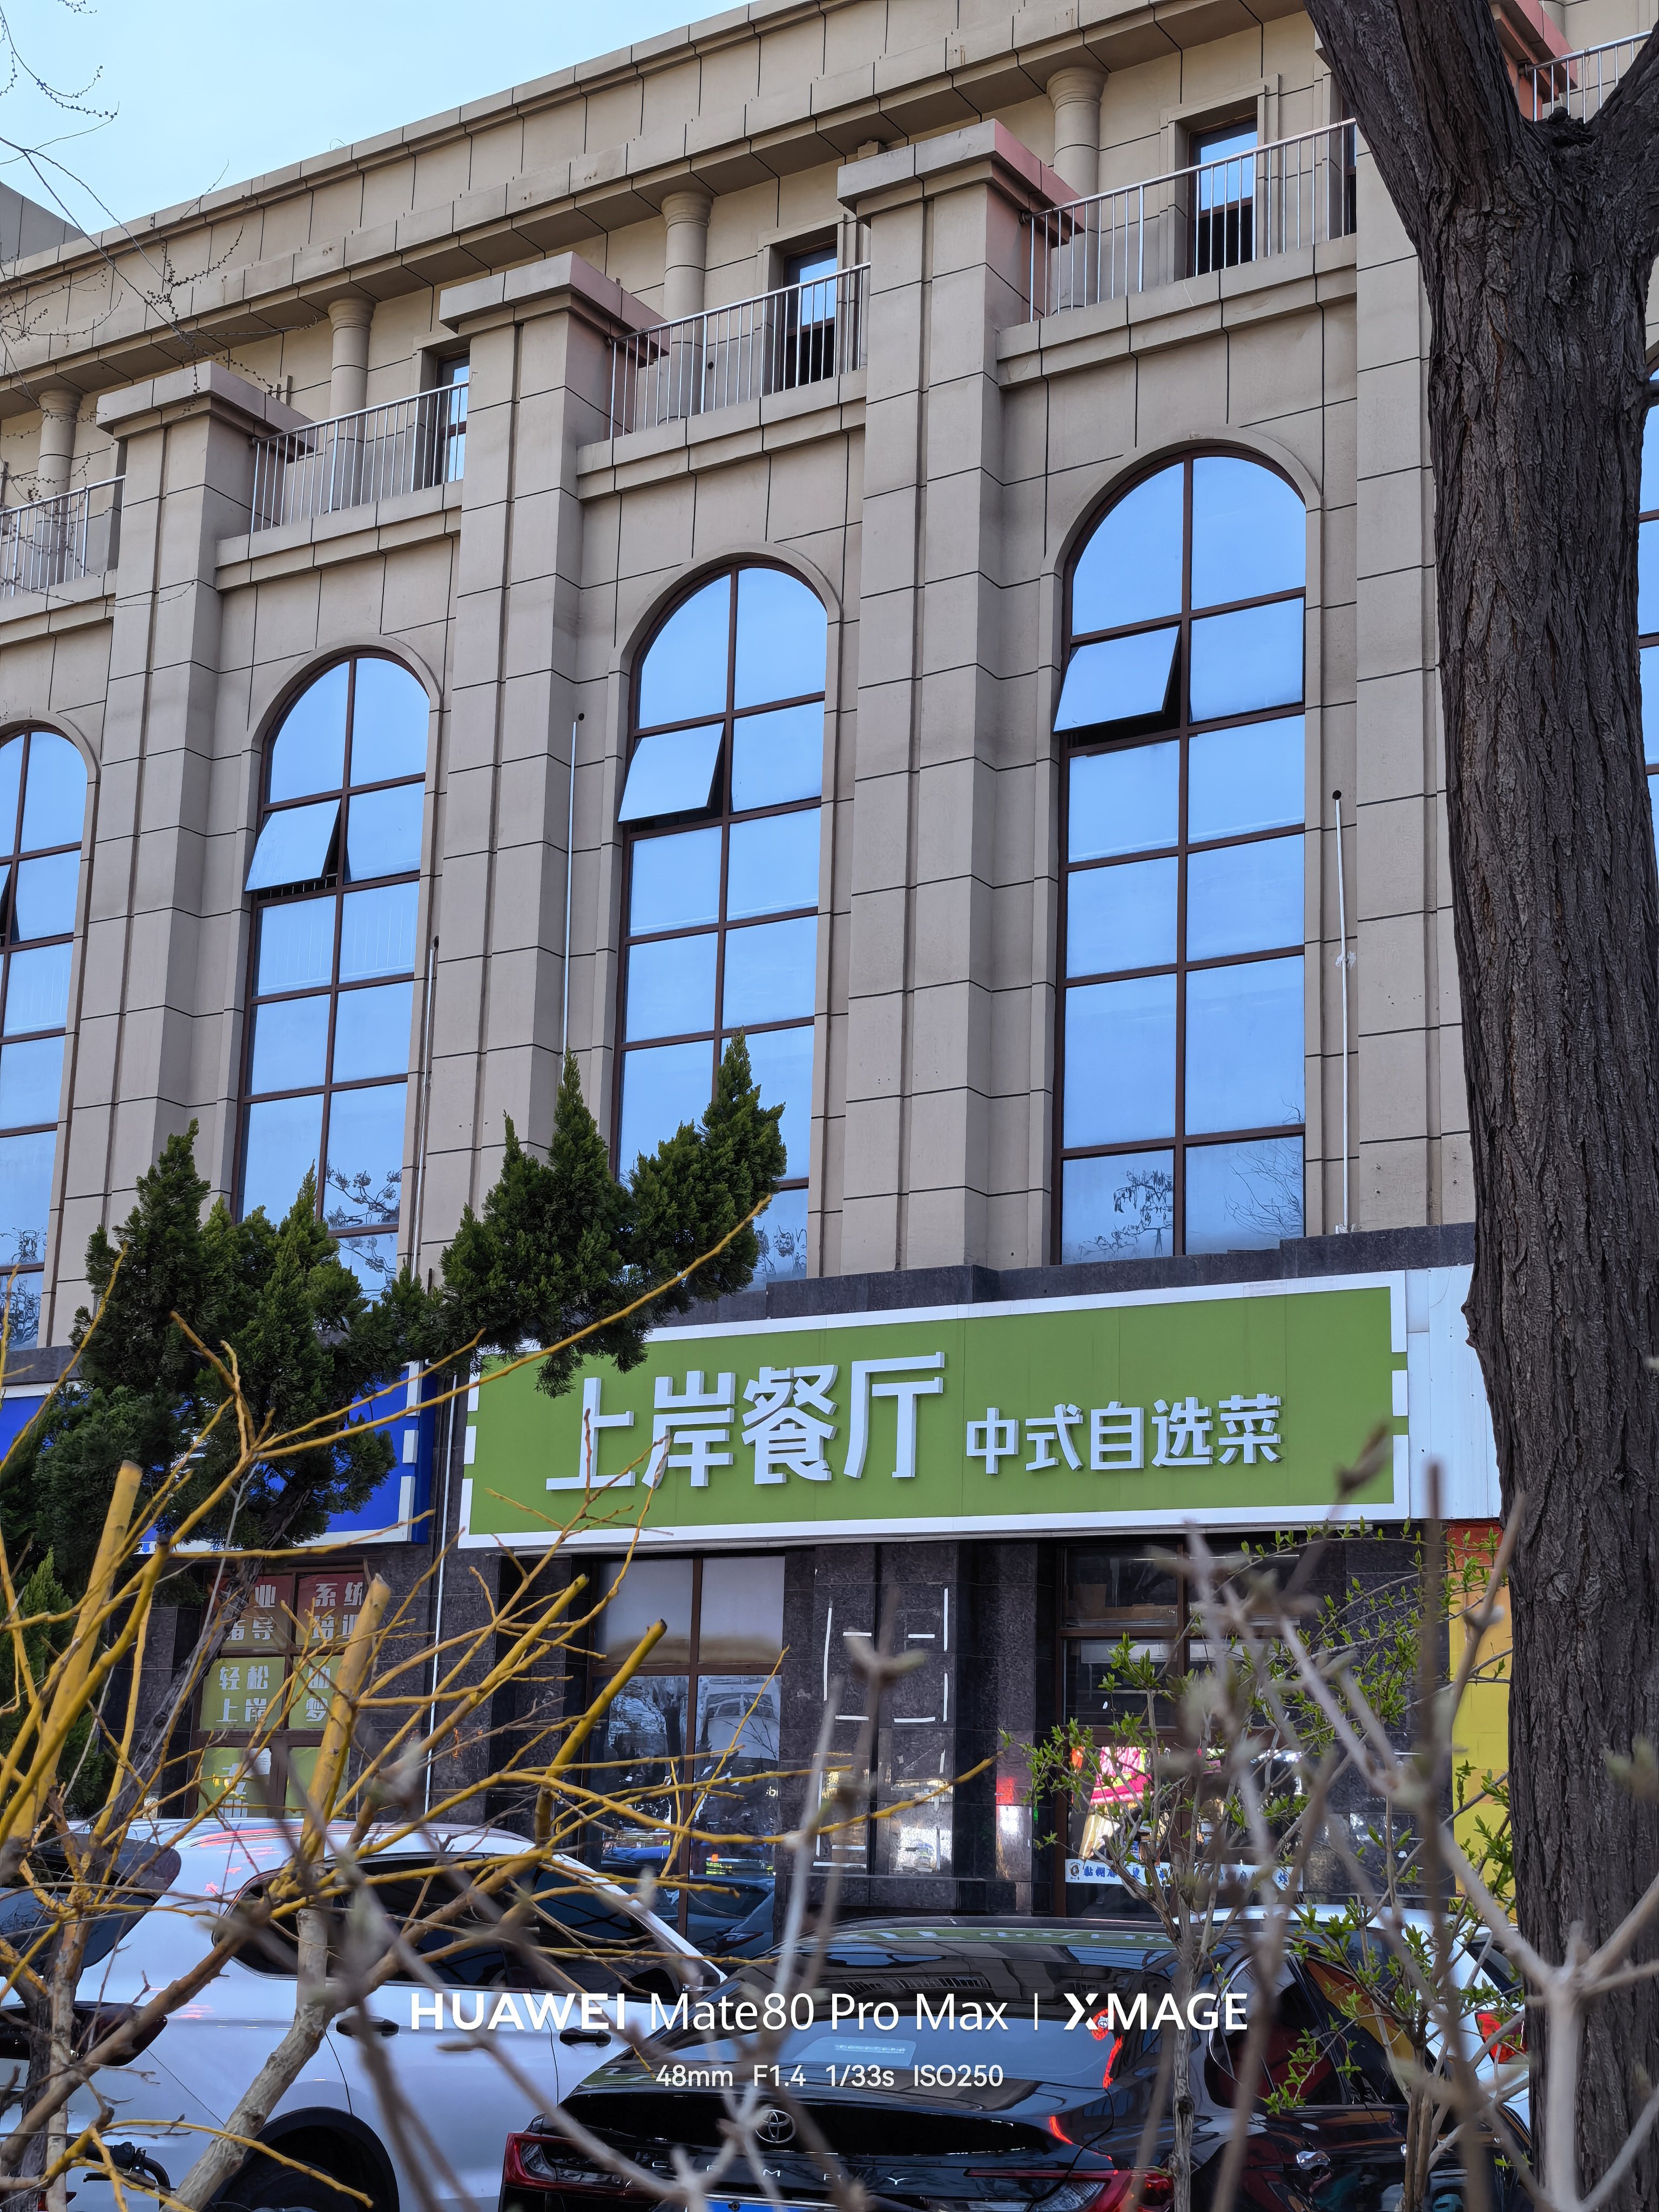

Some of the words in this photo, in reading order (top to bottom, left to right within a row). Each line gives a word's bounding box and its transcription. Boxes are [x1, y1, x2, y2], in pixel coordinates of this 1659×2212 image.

[546, 1351, 945, 1490] 上岸餐厅
[967, 1393, 1282, 1475] 中式自选菜
[219, 1665, 269, 1690] 轻松
[216, 1697, 267, 1723] 上岸
